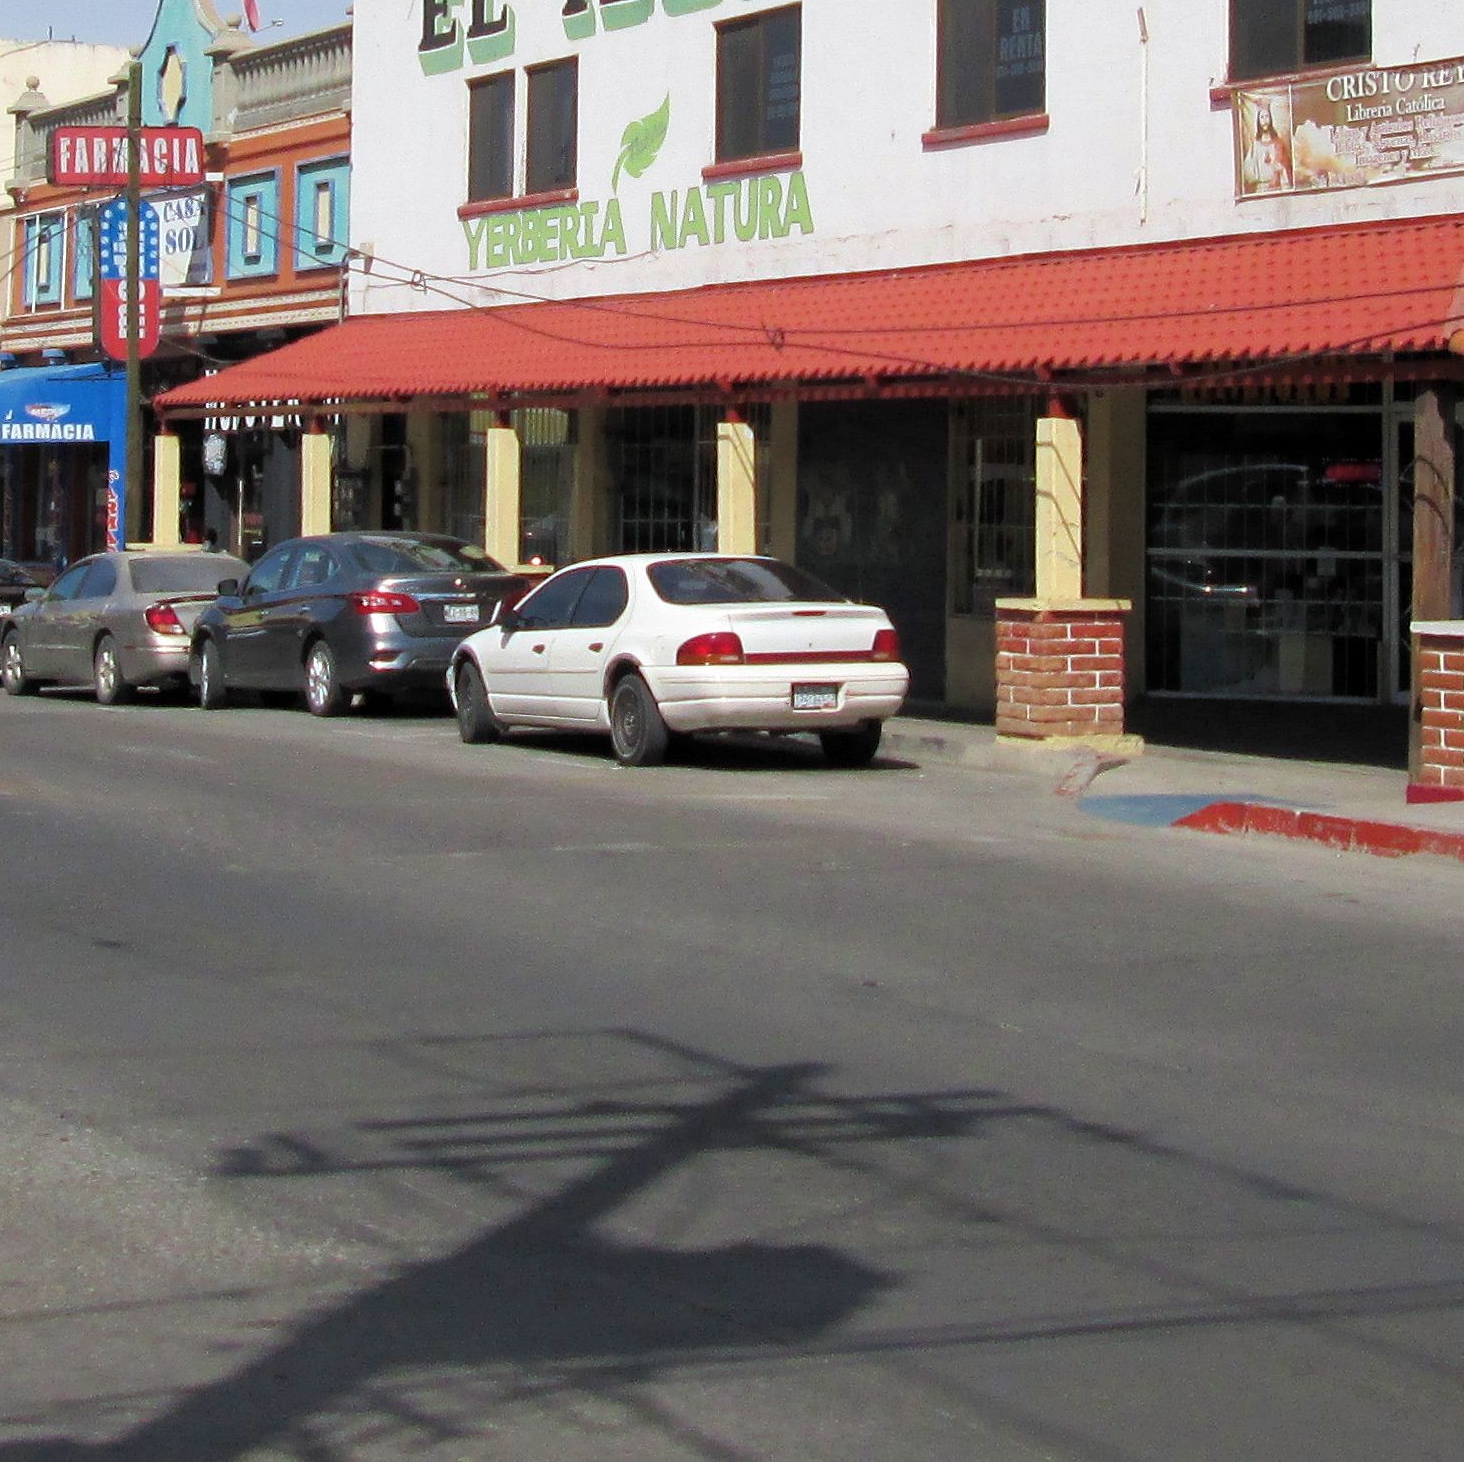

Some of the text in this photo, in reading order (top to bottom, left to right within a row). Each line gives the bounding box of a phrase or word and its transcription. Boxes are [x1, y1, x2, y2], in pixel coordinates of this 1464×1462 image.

[1326, 69, 1414, 102] CRISTO
[59, 138, 199, 174] FARMACIA
[461, 171, 815, 271] YERBERIA NATURA
[1, 423, 95, 441] FARMACIA
